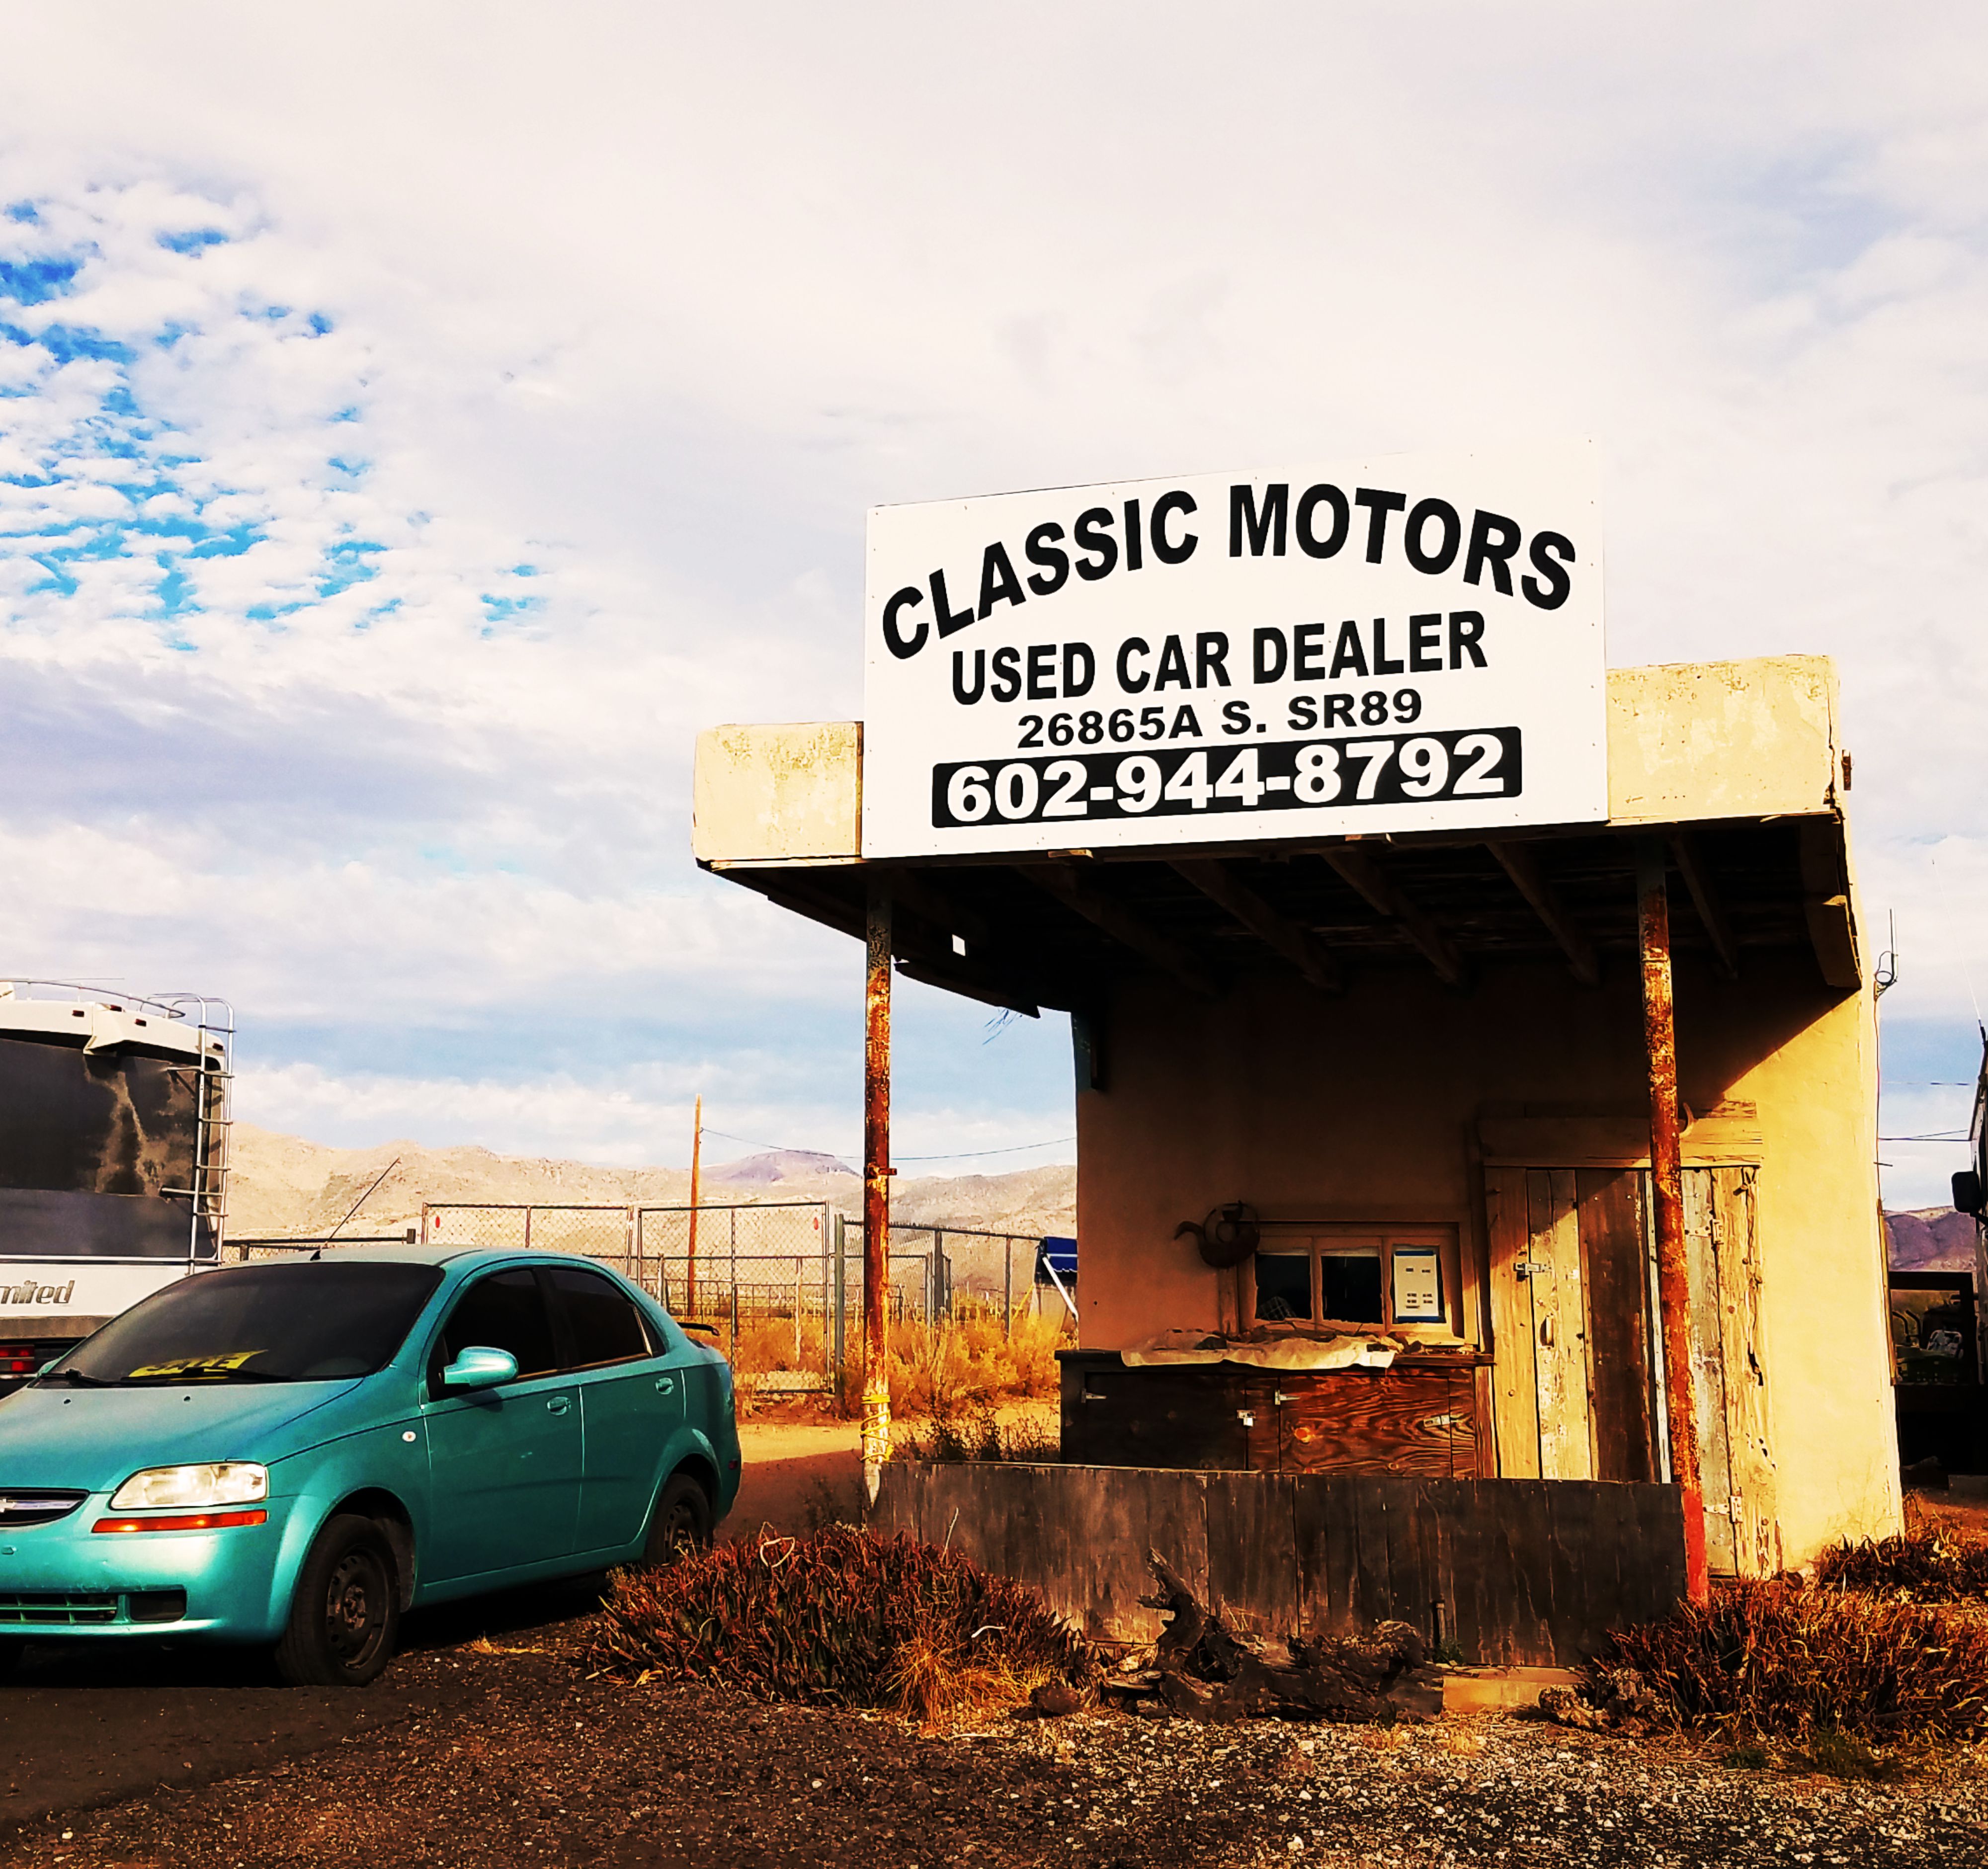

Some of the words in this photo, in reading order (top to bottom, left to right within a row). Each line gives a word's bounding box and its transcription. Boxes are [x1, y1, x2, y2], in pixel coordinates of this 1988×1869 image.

[883, 490, 1198, 659] CLASSIC
[1229, 484, 1575, 611] MOTORS
[953, 642, 1095, 705] USED
[1116, 632, 1232, 694] CAR
[1253, 611, 1488, 684] DEALER
[1017, 704, 1203, 748] 26865A
[1221, 701, 1267, 735] S.
[1287, 688, 1421, 731] SR89
[947, 734, 1504, 821] 602-944-8792
